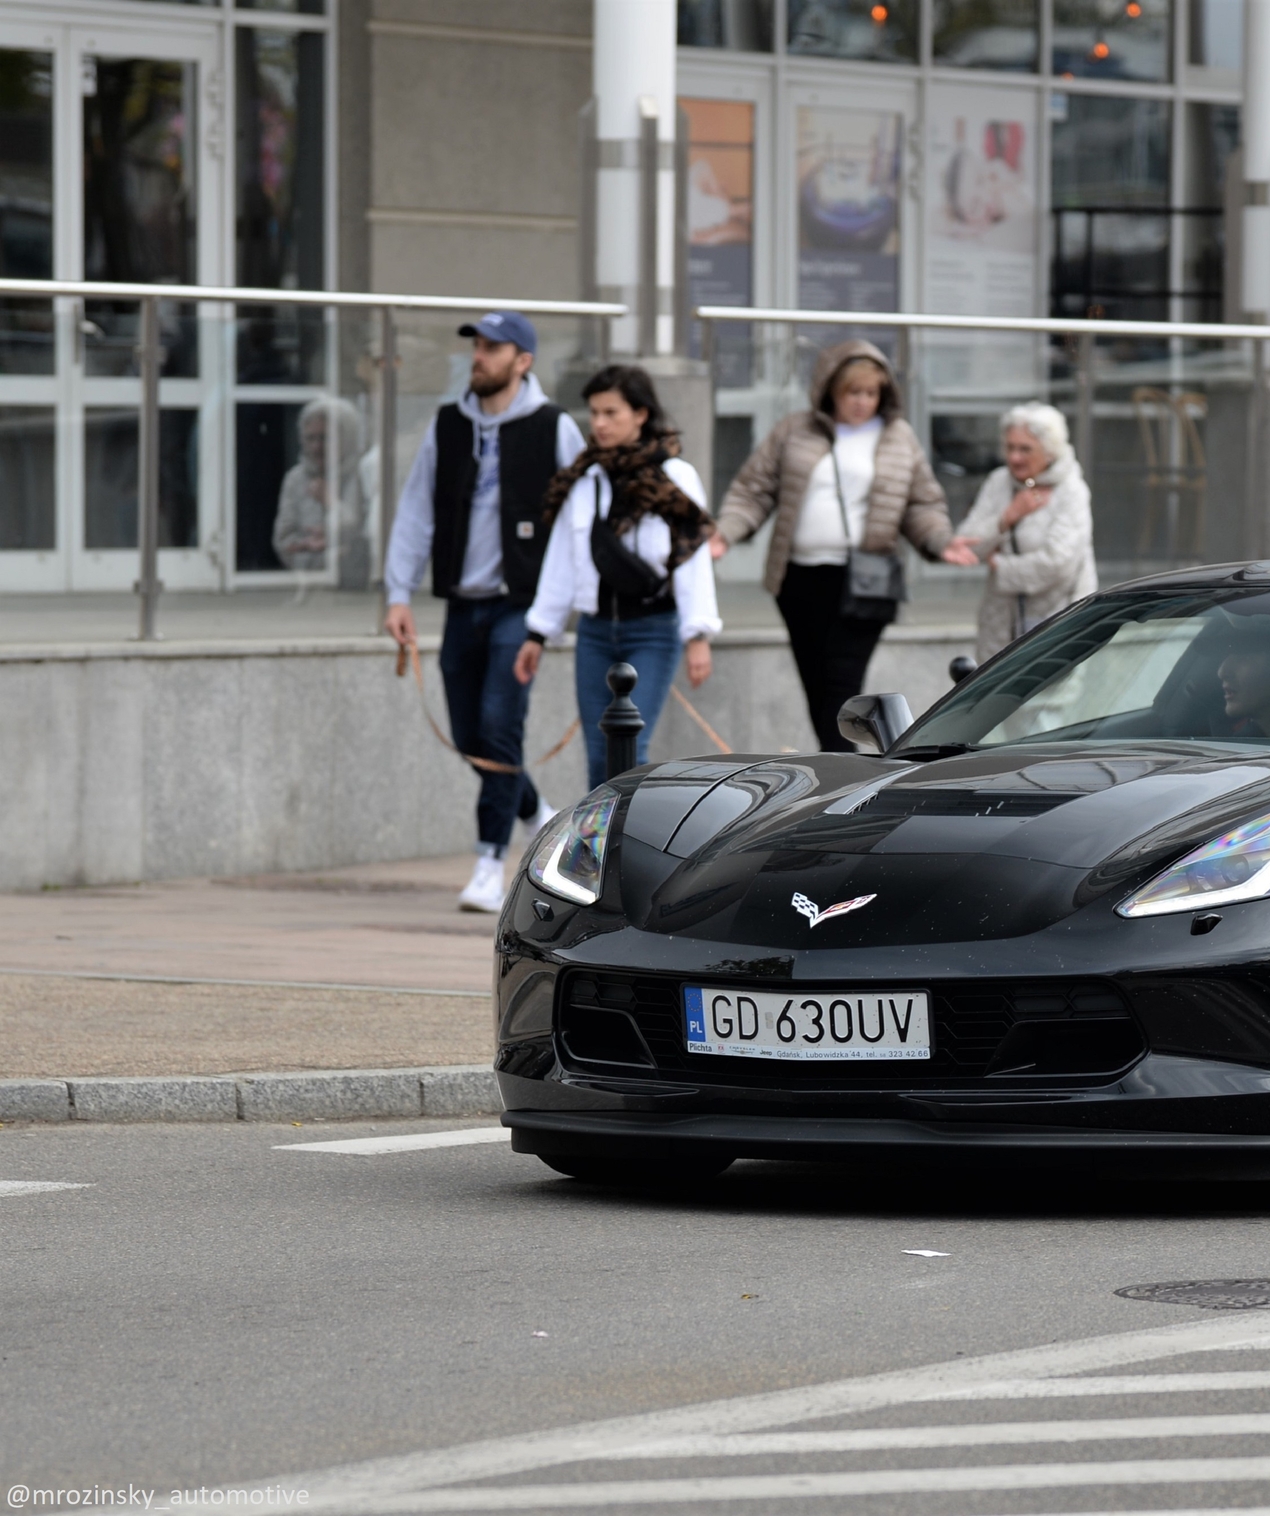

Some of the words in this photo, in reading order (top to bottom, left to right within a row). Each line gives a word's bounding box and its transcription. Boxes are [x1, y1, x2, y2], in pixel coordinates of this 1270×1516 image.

[711, 994, 759, 1040] GD
[775, 998, 914, 1044] 630UV
[689, 1020, 703, 1034] PL
[689, 1042, 713, 1053] Plichta
[805, 1050, 849, 1058] Lubowidzka
[866, 1050, 877, 1058] tel.
[888, 1050, 903, 1058] 323
[905, 1050, 916, 1058] 42
[918, 1049, 929, 1057] 66
